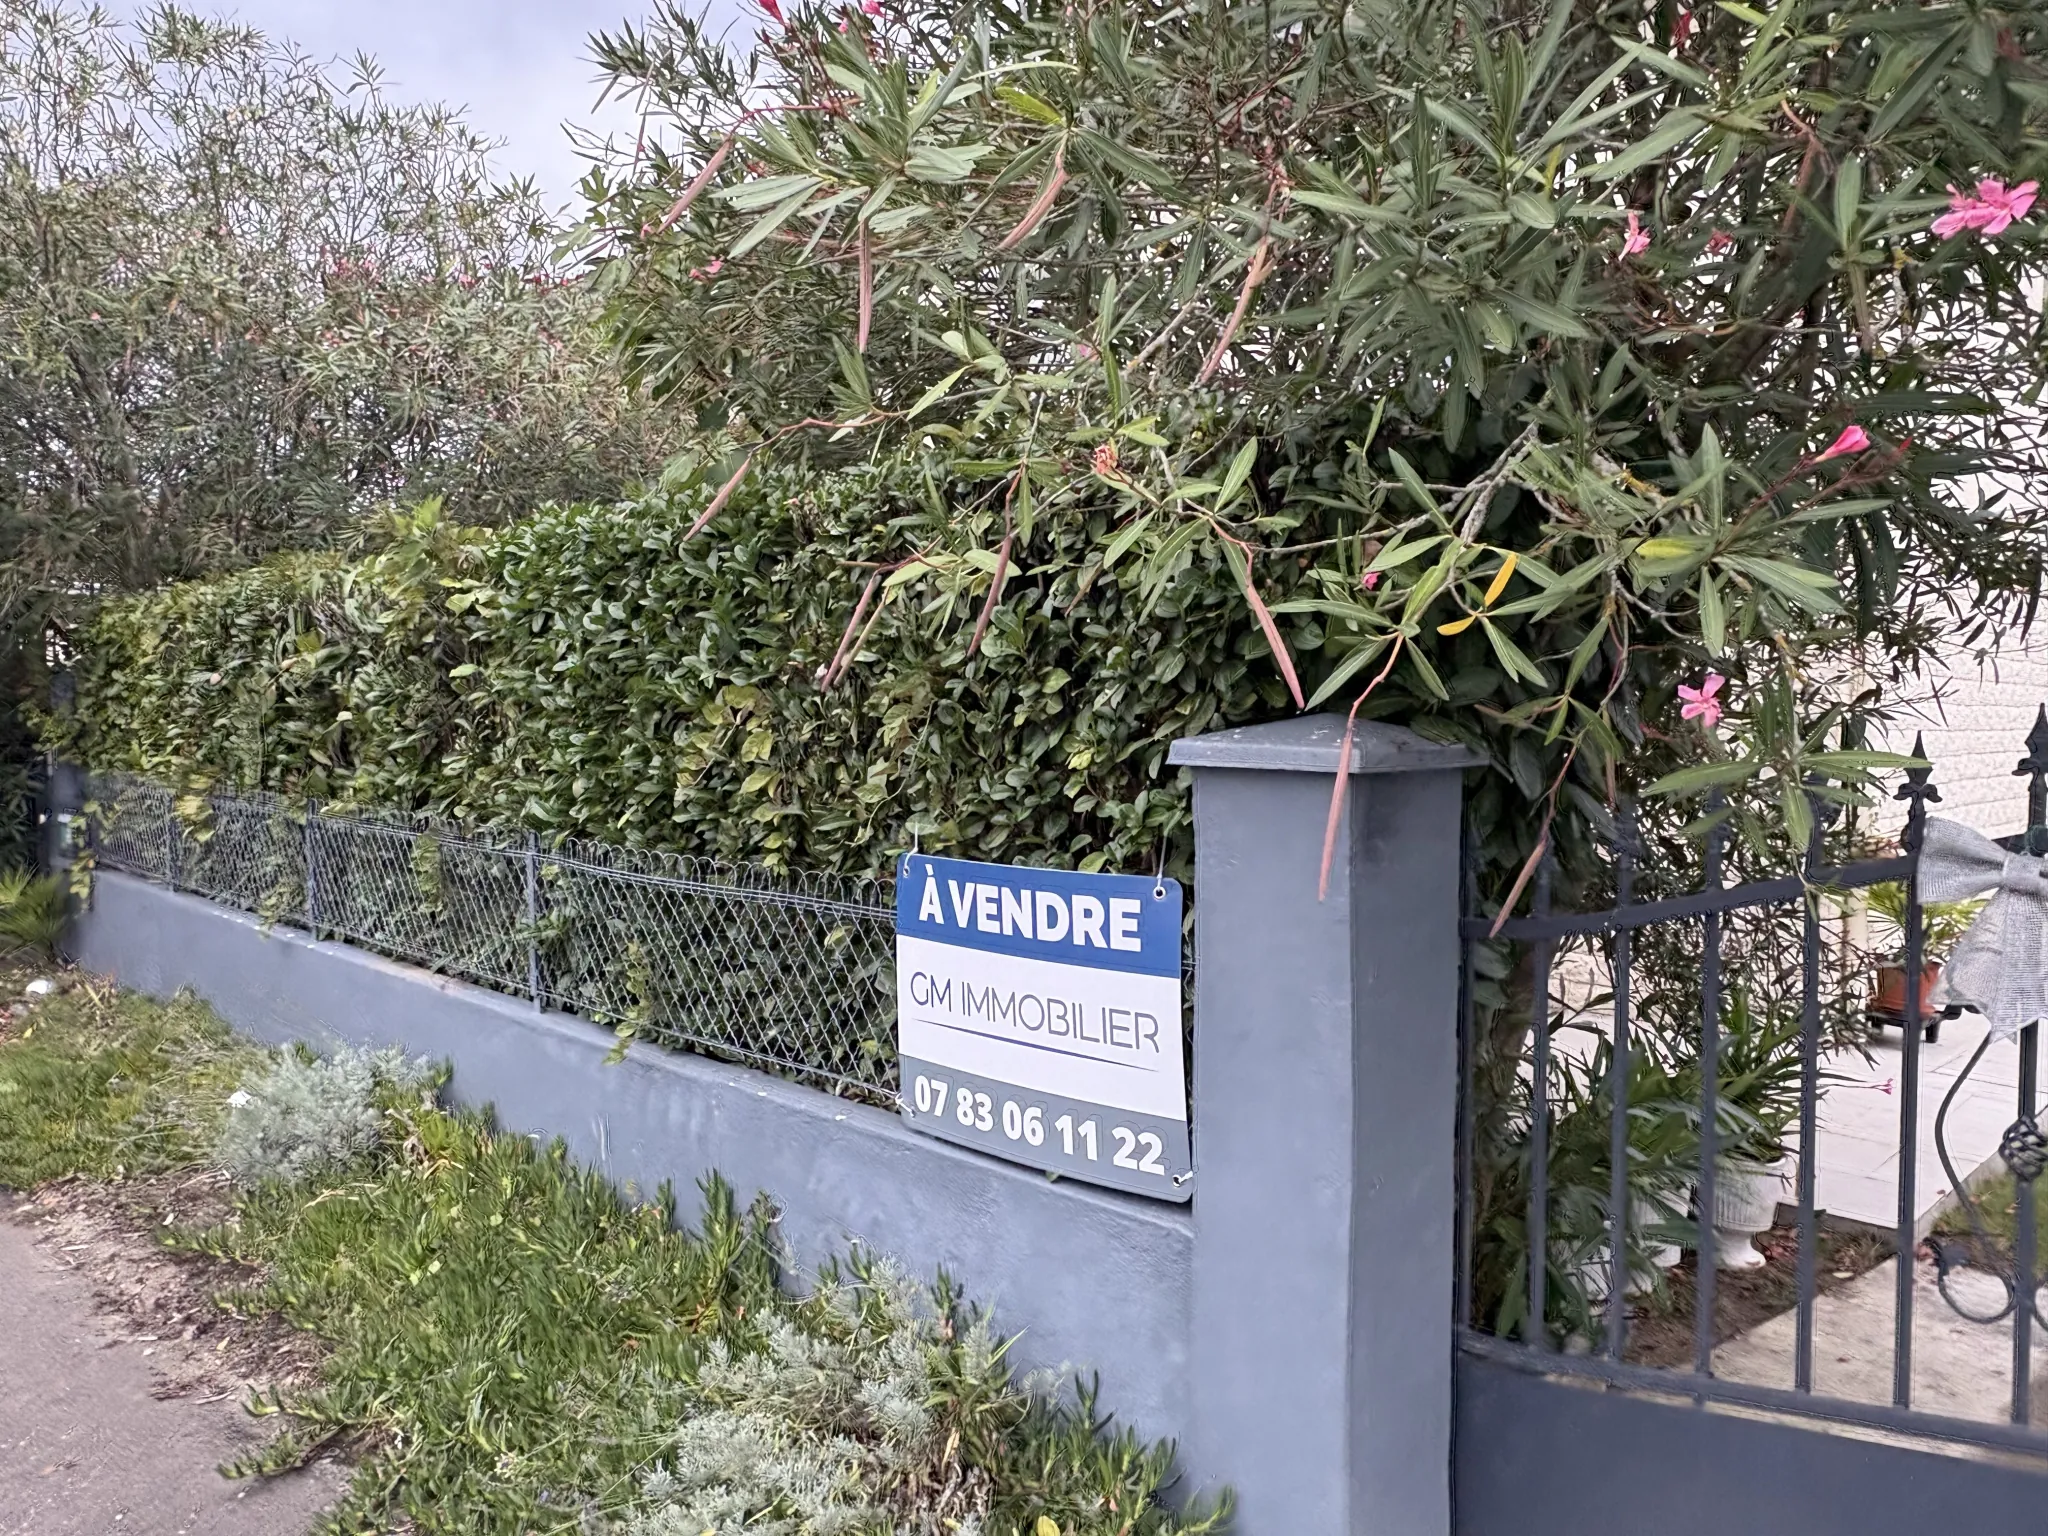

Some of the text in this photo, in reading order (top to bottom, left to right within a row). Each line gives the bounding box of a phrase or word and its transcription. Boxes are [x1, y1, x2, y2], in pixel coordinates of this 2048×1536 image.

[918, 864, 1142, 952] À VENDRE
[910, 971, 1160, 1053] GM IMMOBILIER
[914, 1074, 1165, 1176] 07 83 06 11 22
